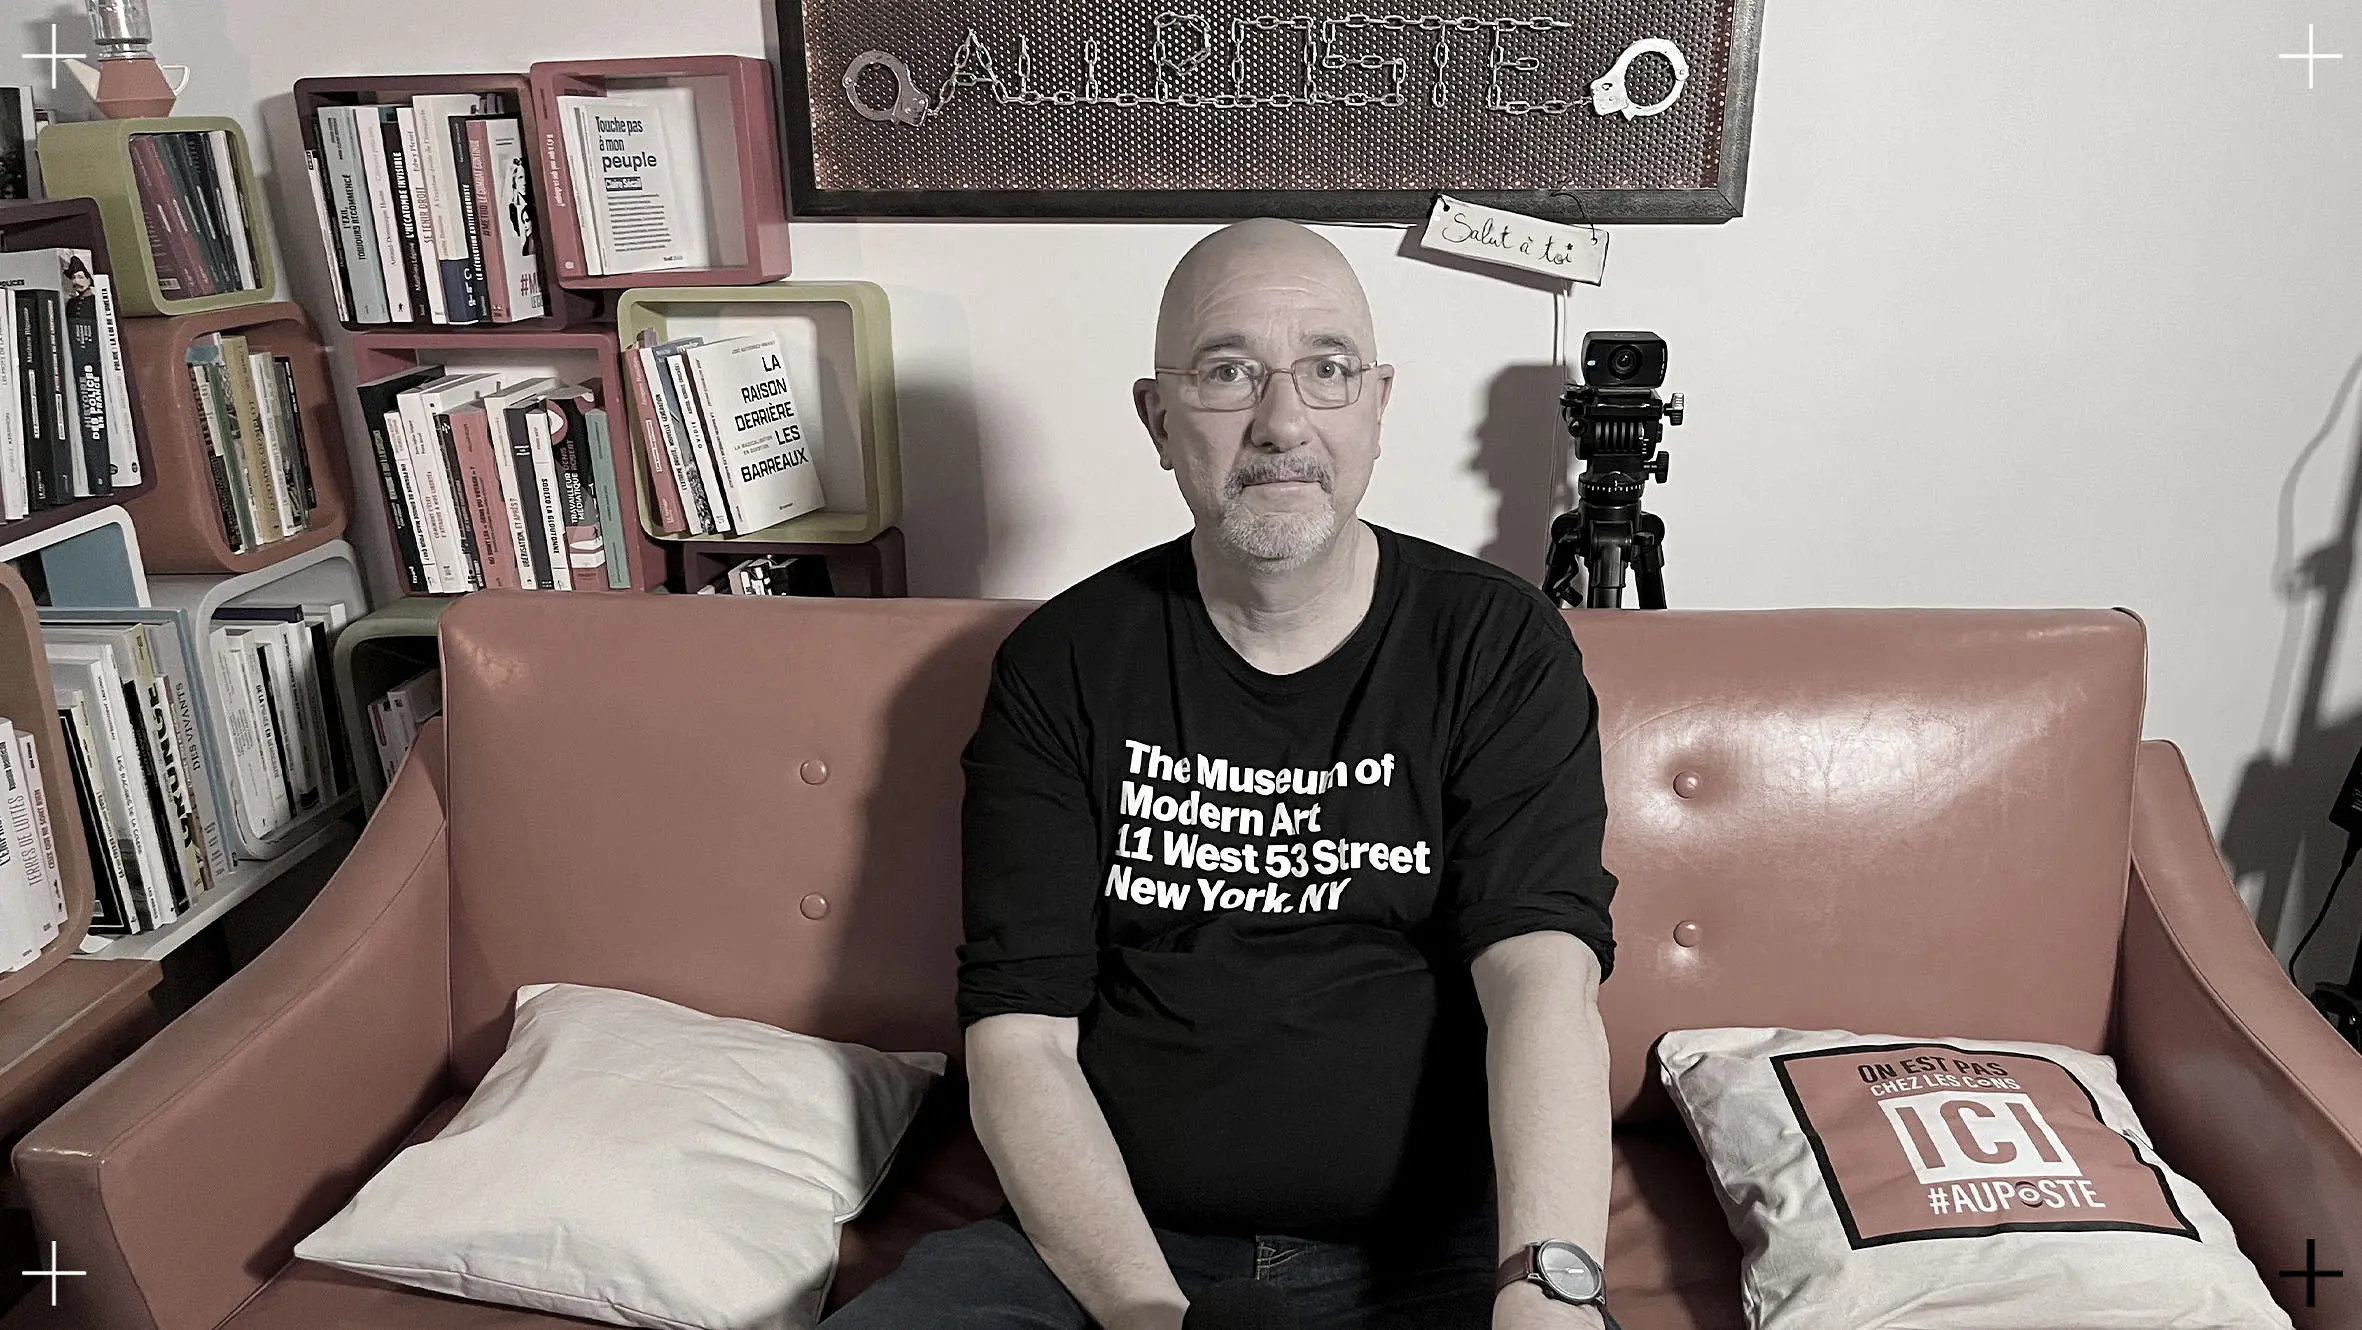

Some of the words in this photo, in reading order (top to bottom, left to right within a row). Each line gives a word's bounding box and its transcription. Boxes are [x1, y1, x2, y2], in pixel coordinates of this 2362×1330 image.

[1153, 11, 1571, 111] POSTE
[595, 116, 626, 133] Touche
[626, 120, 644, 136] pas
[599, 135, 604, 152] à
[606, 138, 625, 152] mon
[392, 150, 406, 188] INVISIBLE
[602, 151, 657, 172] peuple
[343, 173, 359, 227] RECOMMENCÉ
[415, 185, 427, 209] DROIT
[398, 188, 414, 239] L'HÉCATOMBE
[420, 210, 431, 232] TENIR
[354, 226, 364, 259] TOUJOURS
[423, 233, 434, 244] SE
[1442, 212, 1512, 250] Salut
[1519, 236, 1533, 254] à
[1538, 235, 1574, 265] toi
[762, 354, 782, 372] LA
[84, 364, 98, 414] POLICES
[92, 376, 104, 413] FRANCE
[741, 377, 788, 404] RAISON
[78, 376, 92, 427] HISTOIRE
[90, 416, 100, 440] DES
[97, 415, 105, 429] EN
[734, 401, 795, 432] DERRIÈRE
[663, 422, 675, 446] NOUVELLE
[774, 424, 800, 446] LES
[559, 446, 569, 470] DENIS
[565, 438, 578, 471] ROBERT
[740, 448, 808, 483] BARREAUX
[400, 463, 406, 472] UN
[403, 471, 411, 493] POGNON
[472, 475, 480, 498] VOYAGE
[541, 478, 550, 504] SODEXO
[407, 493, 414, 501] DE
[476, 498, 483, 507] DU
[546, 505, 552, 513] LA
[563, 472, 579, 523] TRAVAILLEUR
[410, 500, 418, 520] DINGUE
[478, 508, 486, 523] GENS
[510, 502, 519, 521] APRÈS
[414, 520, 422, 534] MAIS
[429, 512, 438, 539] COMMENT
[482, 529, 490, 540] LES
[514, 521, 521, 529] ET
[548, 514, 559, 554] GLOUTONNE
[418, 533, 426, 548] POUR
[484, 540, 493, 556] SONT
[516, 529, 529, 568] UBÉRISATION,
[487, 556, 495, 565] OÙ
[255, 683, 262, 693] DE
[257, 694, 265, 703] LA
[173, 681, 196, 742] VIVANTS
[265, 728, 272, 738] EN
[148, 682, 191, 848] GRUNGE
[187, 743, 201, 770] DES
[1125, 739, 1191, 784] The
[1197, 753, 1348, 796] Museum
[1354, 753, 1395, 787] of
[33, 788, 42, 806] RIEN
[1120, 780, 1264, 836] Modern
[1270, 802, 1321, 838] Art
[10, 794, 28, 832] LUTTES
[37, 806, 46, 825] SONT
[16, 832, 34, 847] DE
[41, 826, 48, 835] NE
[44, 836, 52, 851] QUI
[1114, 824, 1154, 862] 11
[1163, 830, 1260, 874] West
[1264, 843, 1309, 878] 53
[1312, 838, 1431, 875] Street
[23, 846, 41, 885] TERRES
[46, 852, 55, 869] CEUX
[1104, 863, 1191, 911] New
[1298, 877, 1352, 914] NY
[1857, 1064, 1898, 1084] ON
[1900, 1056, 1950, 1074] EST
[1952, 1059, 2009, 1077] PAS
[1869, 1076, 1924, 1097] CHEZ
[1922, 1074, 1961, 1088] LES
[1962, 1076, 2022, 1091] CONS
[1895, 1099, 2064, 1170] ICI
[1927, 1178, 2107, 1215] #AUPOSTE
